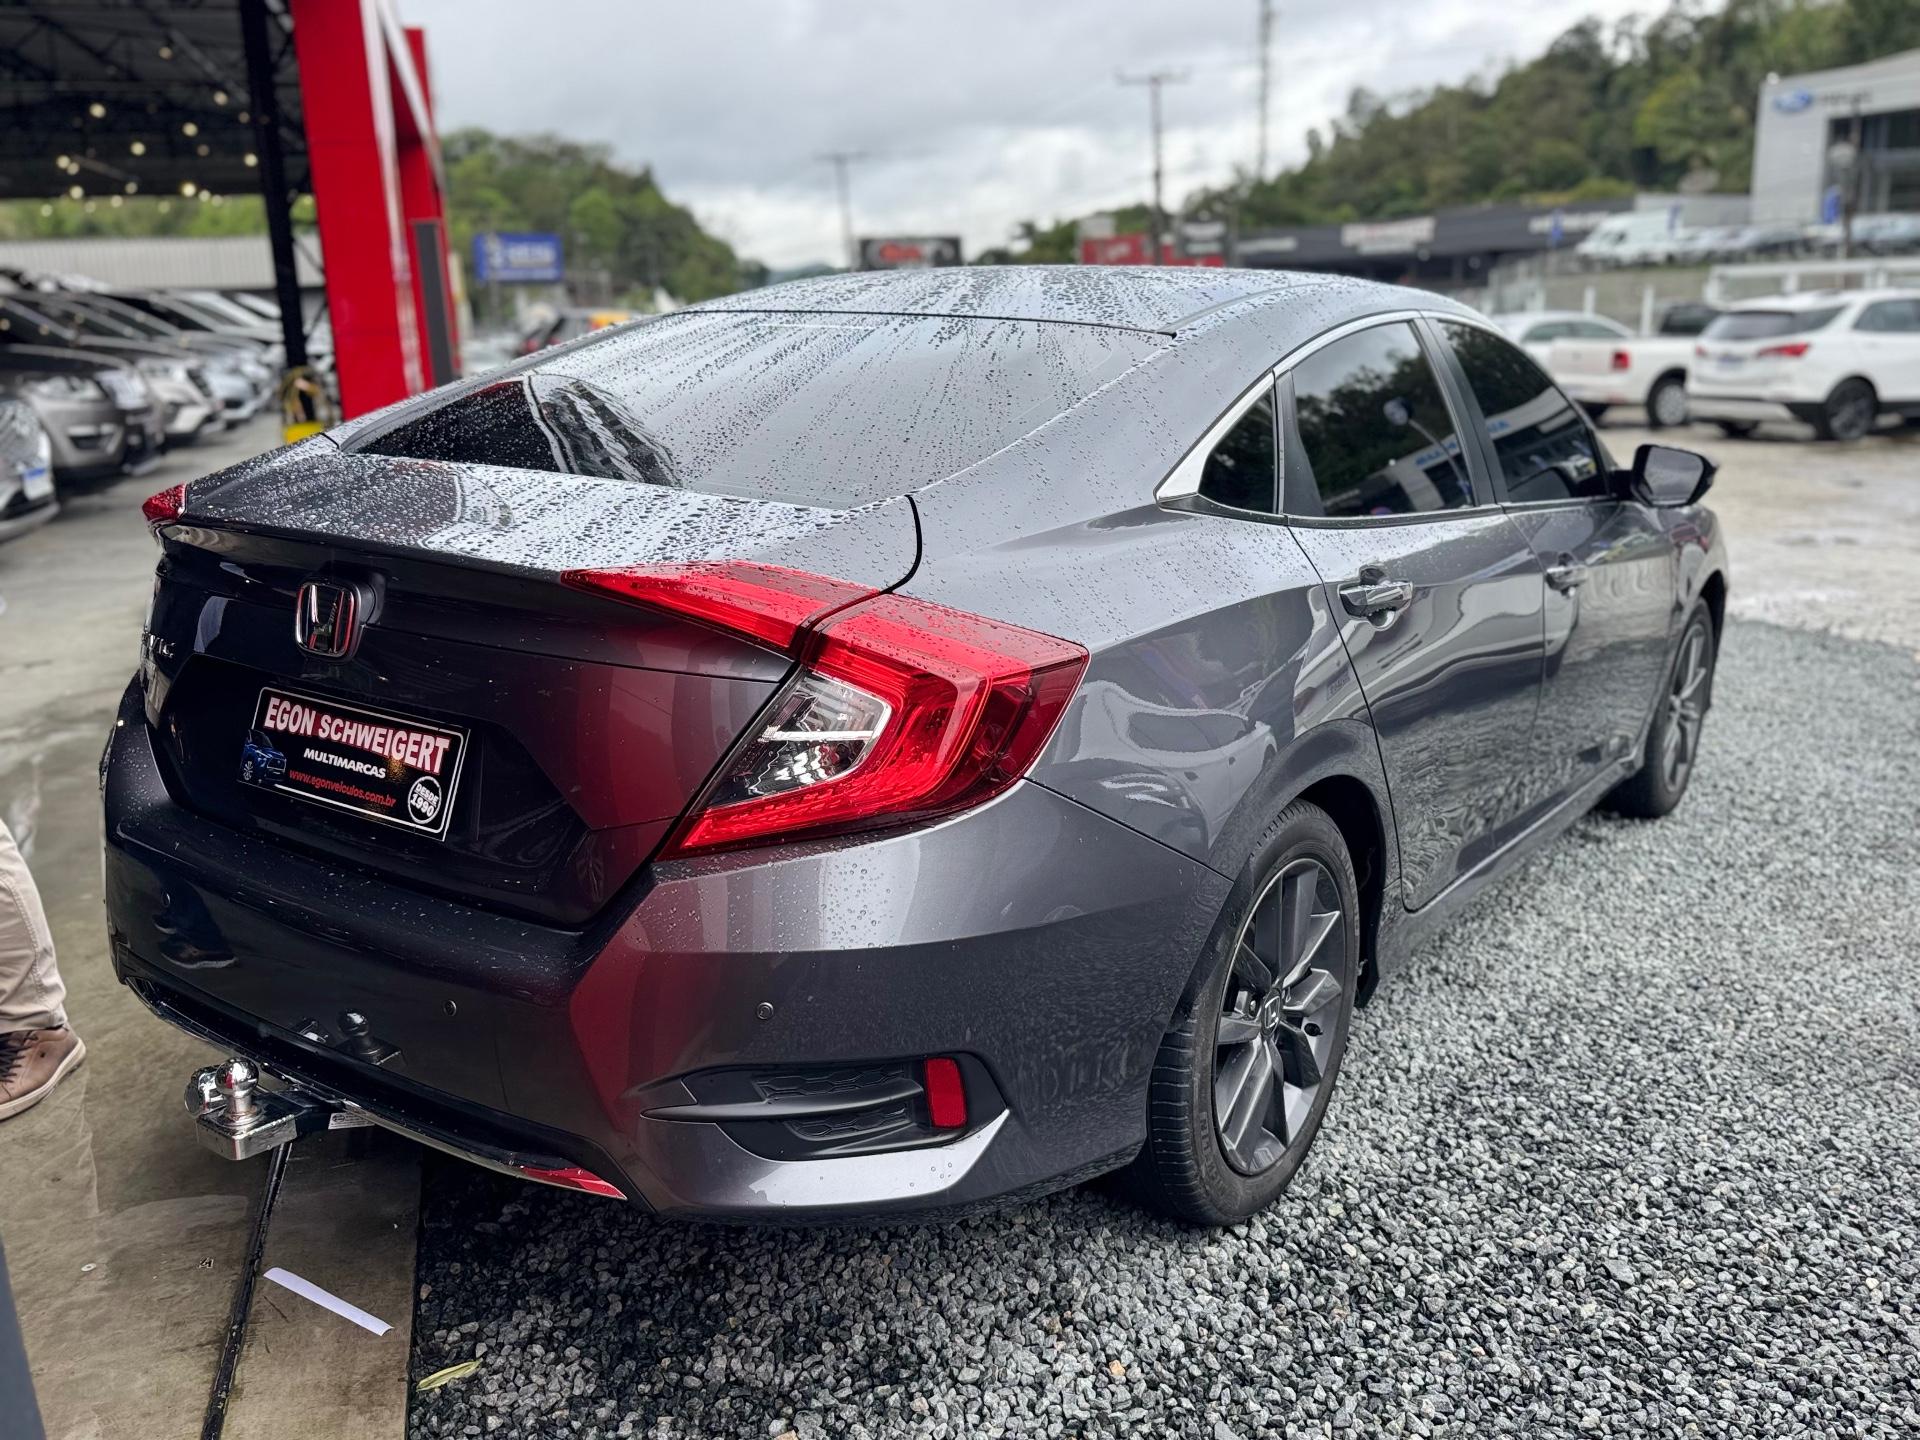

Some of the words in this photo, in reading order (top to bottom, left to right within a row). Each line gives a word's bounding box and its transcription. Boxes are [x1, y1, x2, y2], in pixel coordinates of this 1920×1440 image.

[263, 697, 317, 735] EGON
[318, 714, 450, 775] SCHWEIGERT
[303, 748, 387, 779] MULTIMARCAS
[289, 769, 397, 807] www.egonveiculos.com.br
[415, 783, 439, 804] DESDE
[410, 793, 435, 817] 1990
